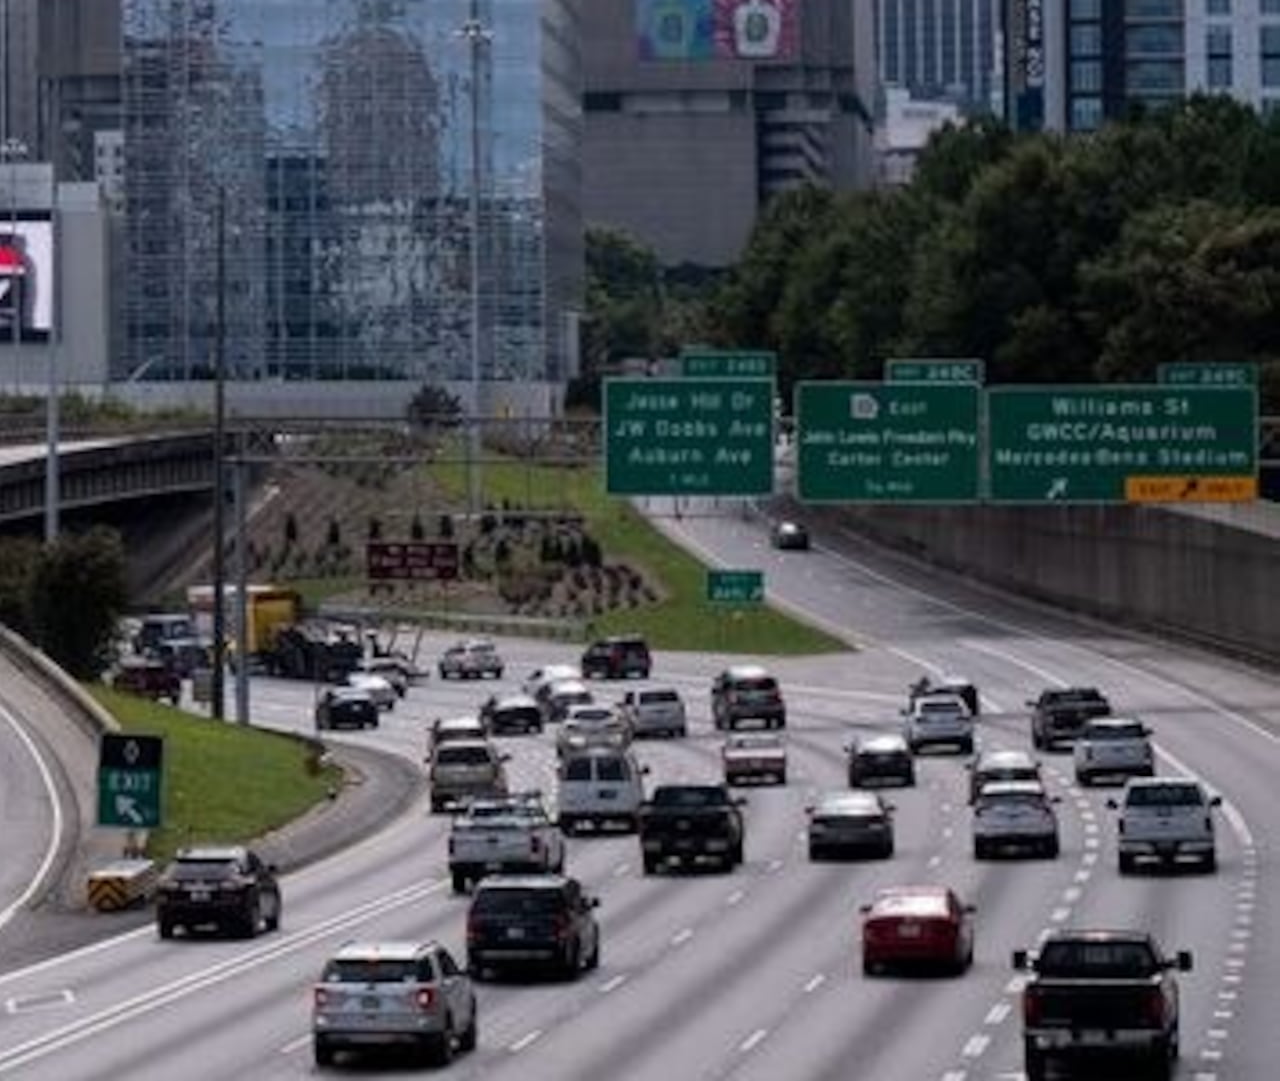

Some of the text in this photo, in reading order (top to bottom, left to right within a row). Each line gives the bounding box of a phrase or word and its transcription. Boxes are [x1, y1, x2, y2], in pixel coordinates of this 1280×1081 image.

[626, 392, 678, 410] Jesse
[730, 392, 754, 410] Dr
[1052, 398, 1189, 415] Williams St
[615, 421, 766, 437] JW Dobbs Ave
[1026, 423, 1217, 443] GWCC/Aquarium
[627, 448, 752, 465] Auburn Ave
[828, 451, 949, 468] Carter Center
[1159, 448, 1247, 466] Stadium
[108, 771, 151, 792] EXIT
